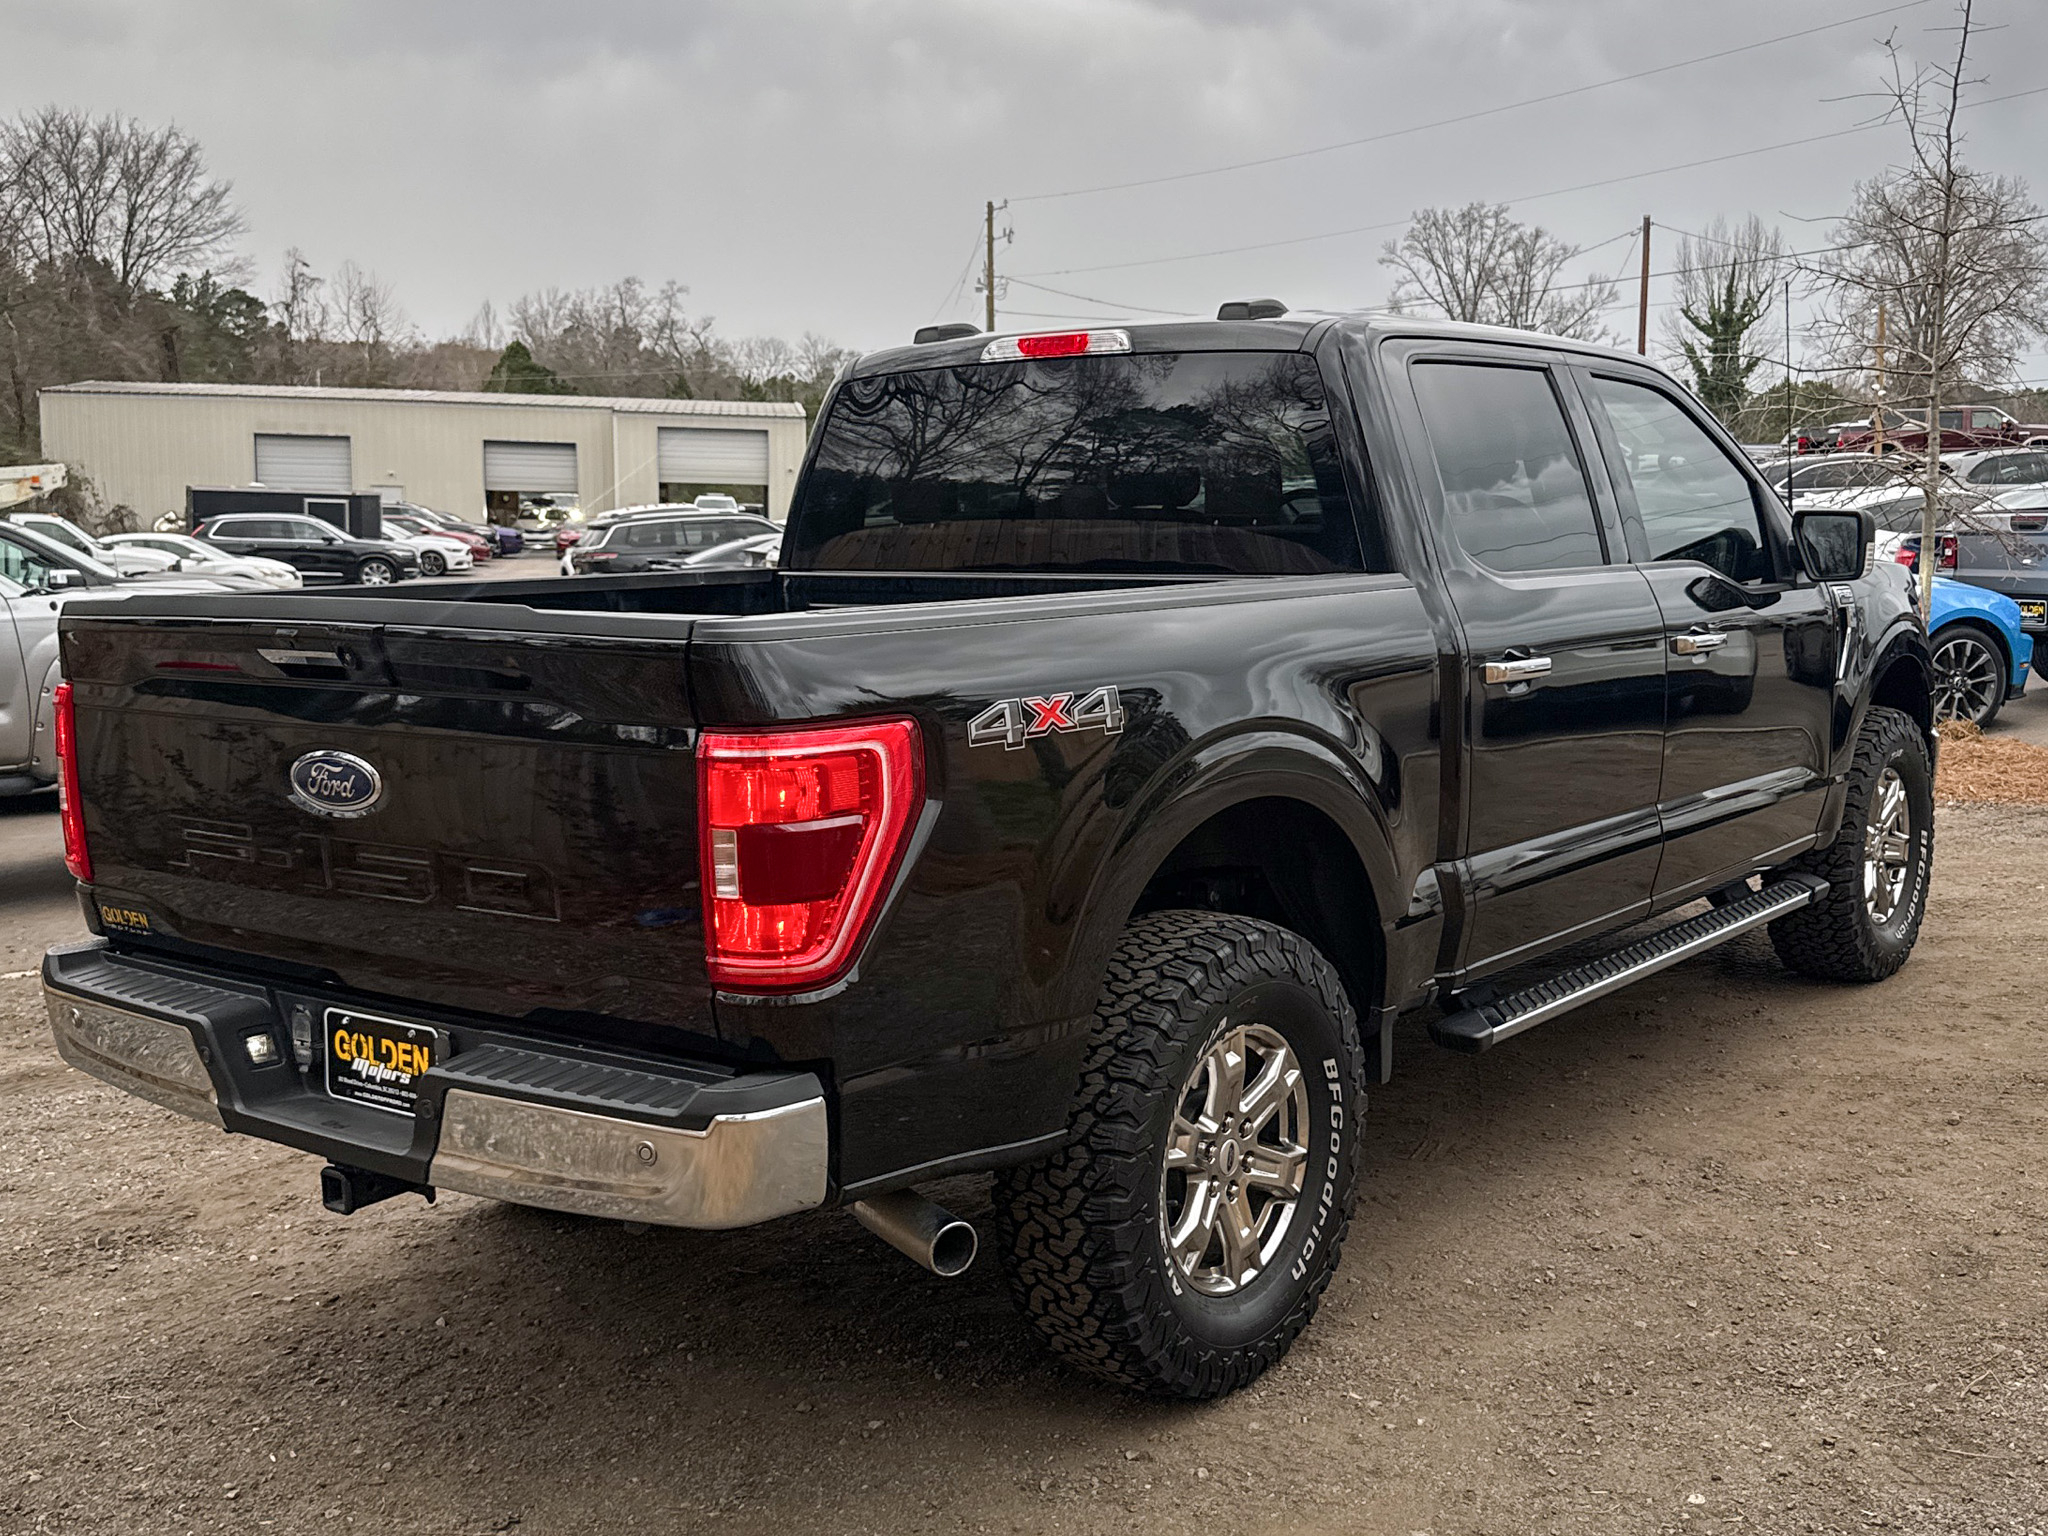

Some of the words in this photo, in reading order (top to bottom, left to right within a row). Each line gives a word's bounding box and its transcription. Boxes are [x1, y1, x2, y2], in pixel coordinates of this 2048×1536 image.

[2020, 605, 2044, 615] OLDEN
[307, 762, 356, 798] Ford
[1894, 829, 1928, 941] BFGoodrich
[102, 905, 149, 929] GOLDEN
[334, 1028, 429, 1077] GOLDEN
[1290, 1057, 1344, 1282] BFGoodrich
